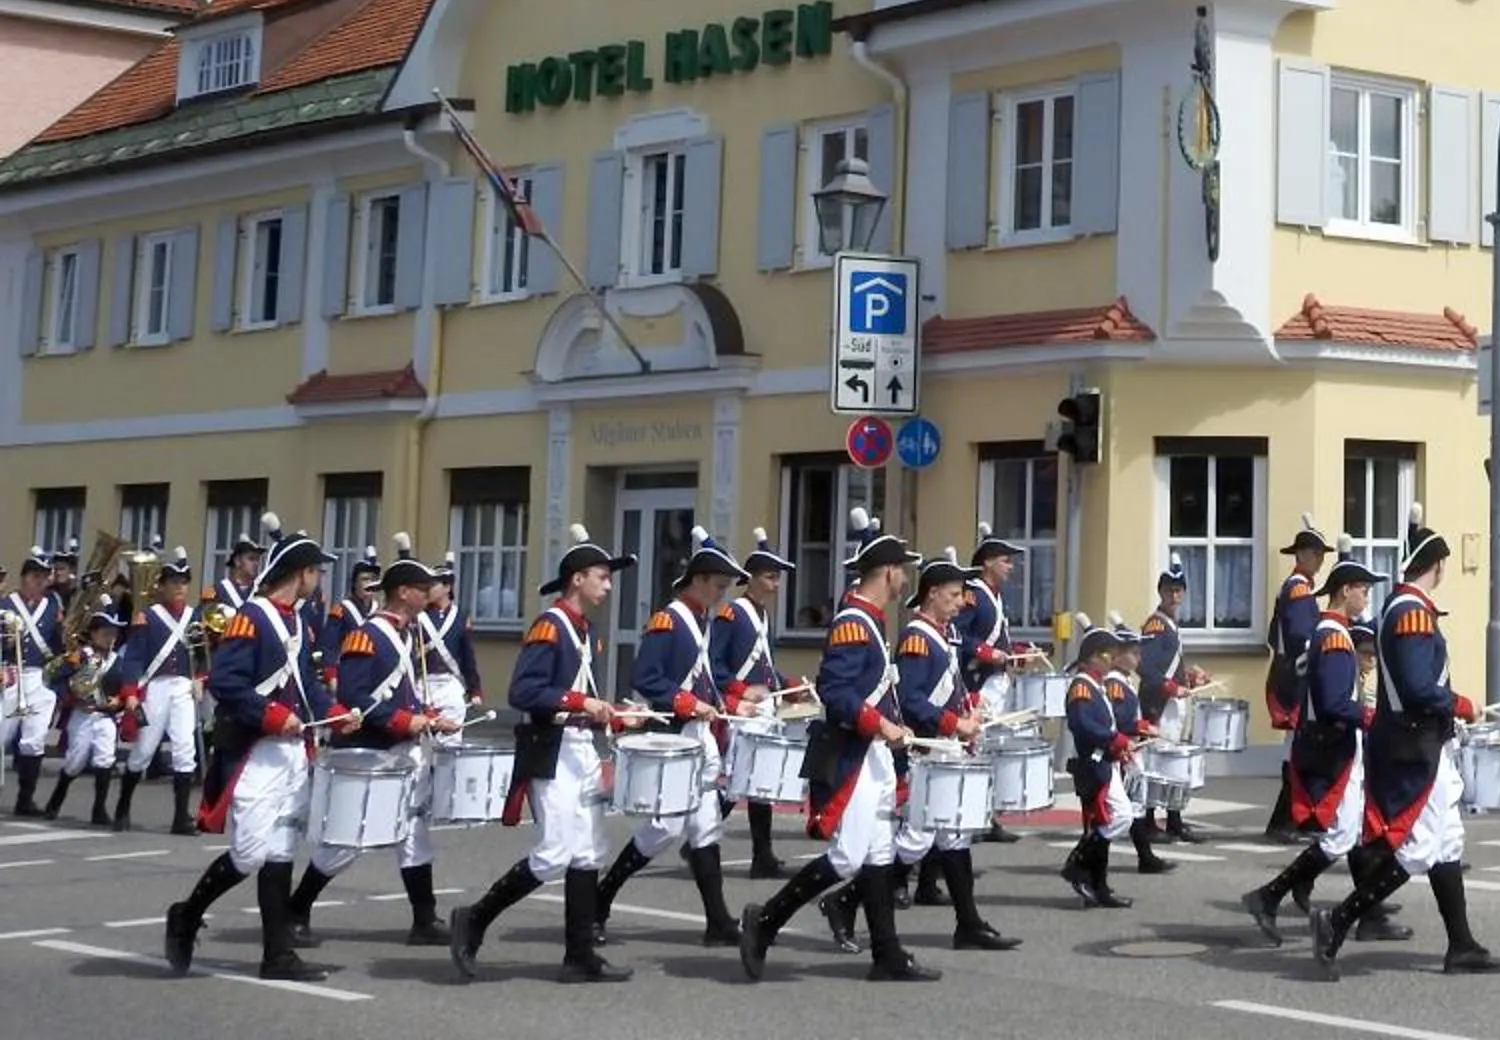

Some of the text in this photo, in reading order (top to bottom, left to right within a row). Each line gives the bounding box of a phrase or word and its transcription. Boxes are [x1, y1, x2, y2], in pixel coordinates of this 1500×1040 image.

[506, 0, 833, 114] HOTEL HASEN
[865, 292, 890, 329] P
